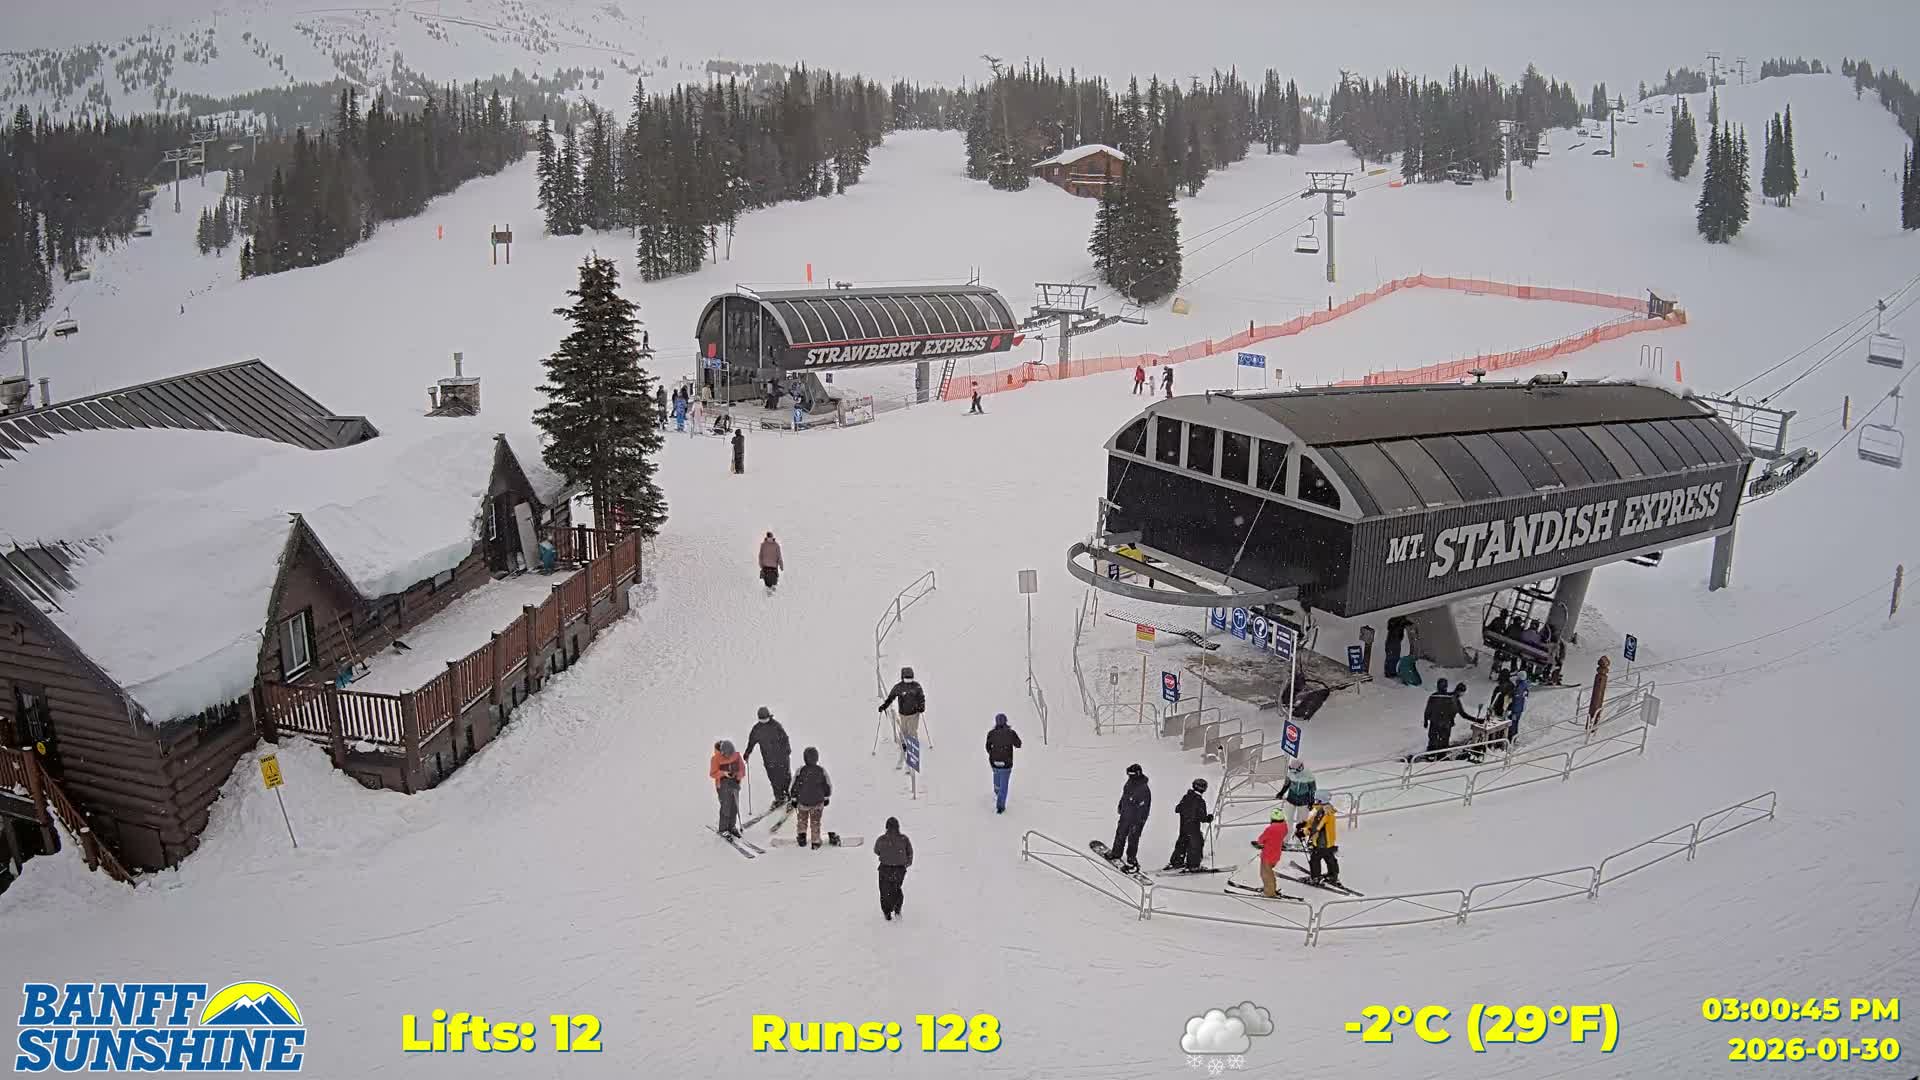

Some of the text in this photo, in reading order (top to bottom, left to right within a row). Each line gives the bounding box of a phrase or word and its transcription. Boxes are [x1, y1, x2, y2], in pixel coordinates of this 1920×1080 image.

[804, 336, 989, 366] STRAWBERRY EXPRESS
[1385, 481, 1723, 579] MT. STANDISH EXPRESS
